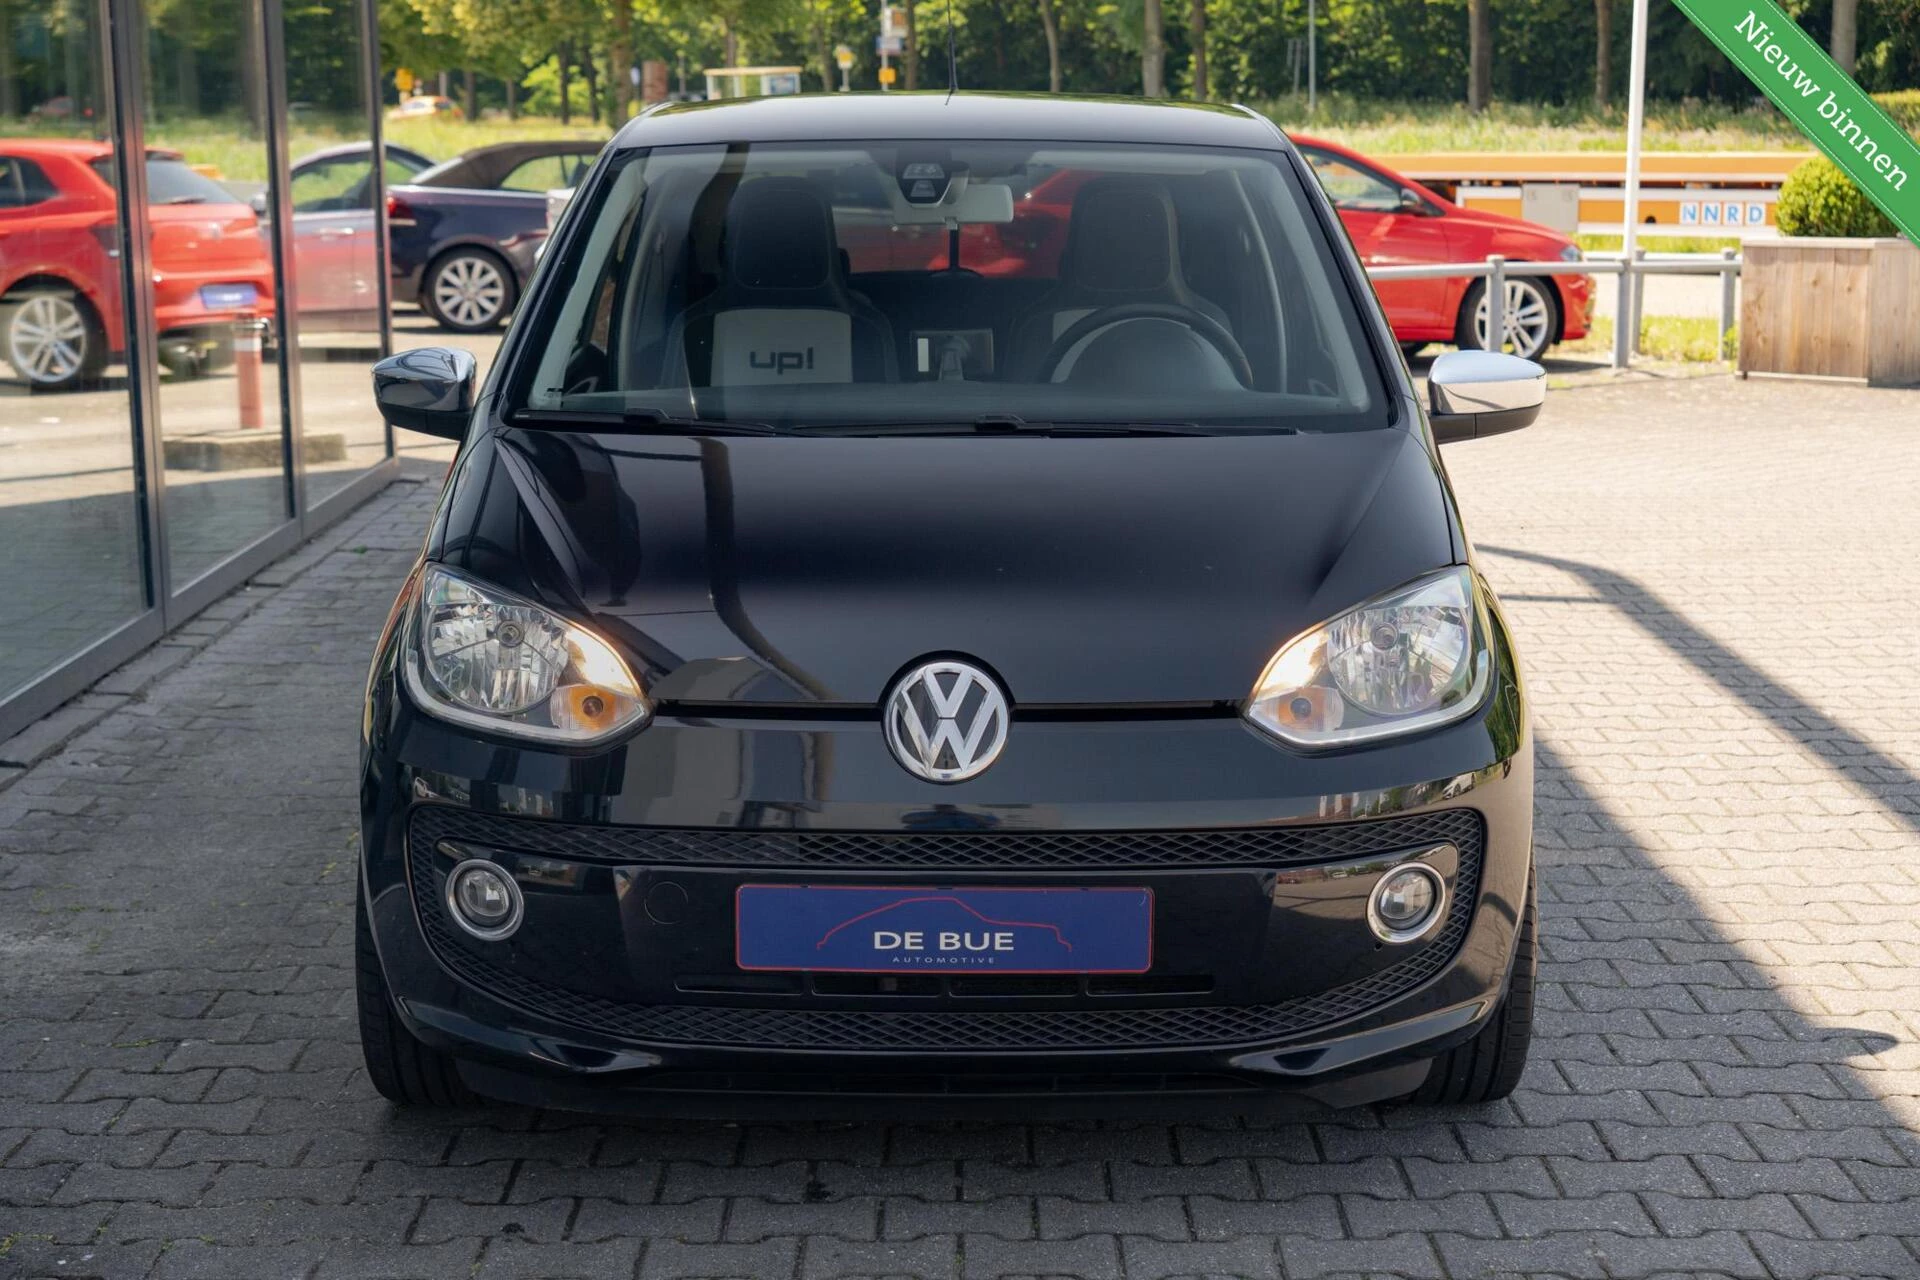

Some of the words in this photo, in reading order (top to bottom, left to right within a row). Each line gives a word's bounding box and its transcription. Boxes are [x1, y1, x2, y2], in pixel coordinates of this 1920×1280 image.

[750, 347, 814, 375] up!
[885, 662, 1009, 781] VW
[873, 931, 925, 950] DE
[939, 932, 1015, 951] BUE
[892, 956, 995, 964] AUTOMOTIVE
